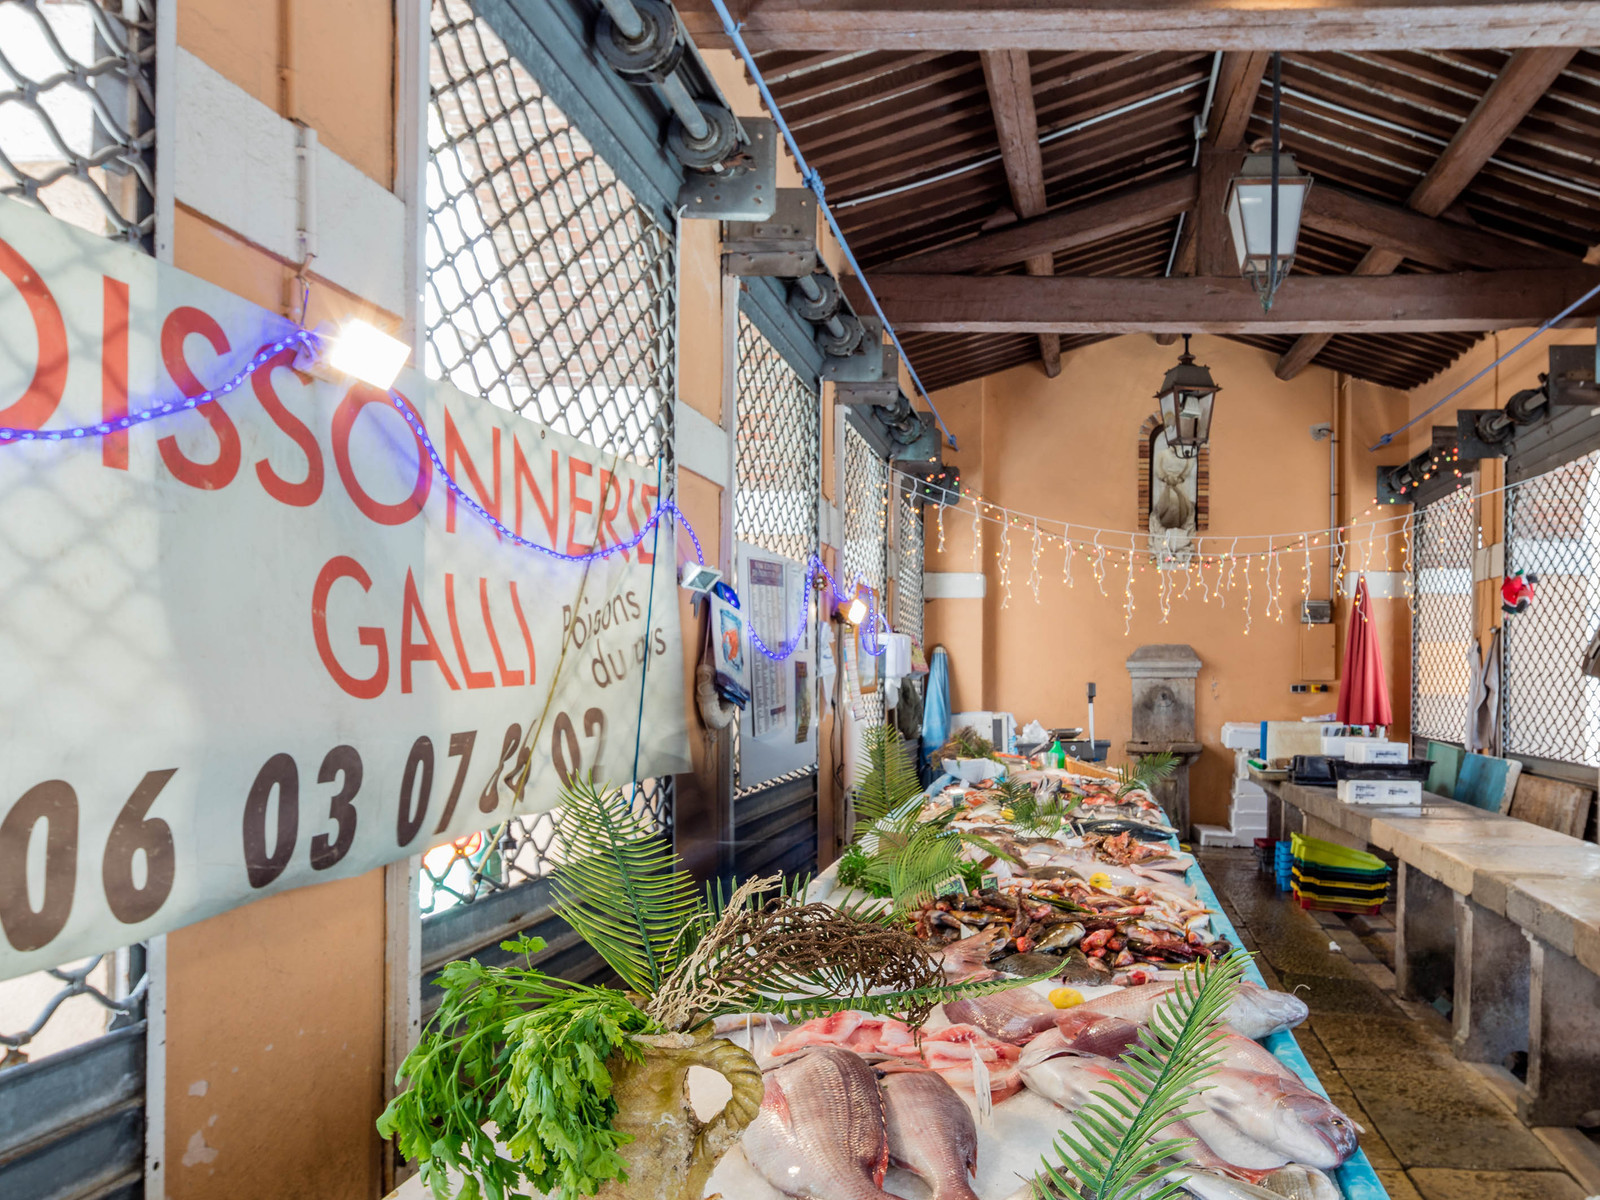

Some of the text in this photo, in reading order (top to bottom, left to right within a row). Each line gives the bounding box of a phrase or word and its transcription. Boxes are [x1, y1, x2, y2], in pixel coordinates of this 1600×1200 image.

[312, 555, 537, 699] GALLI
[592, 639, 627, 688] du
[0, 768, 179, 952] 06
[243, 745, 364, 888] 03
[397, 730, 478, 847] 07
[552, 707, 607, 790] 02
